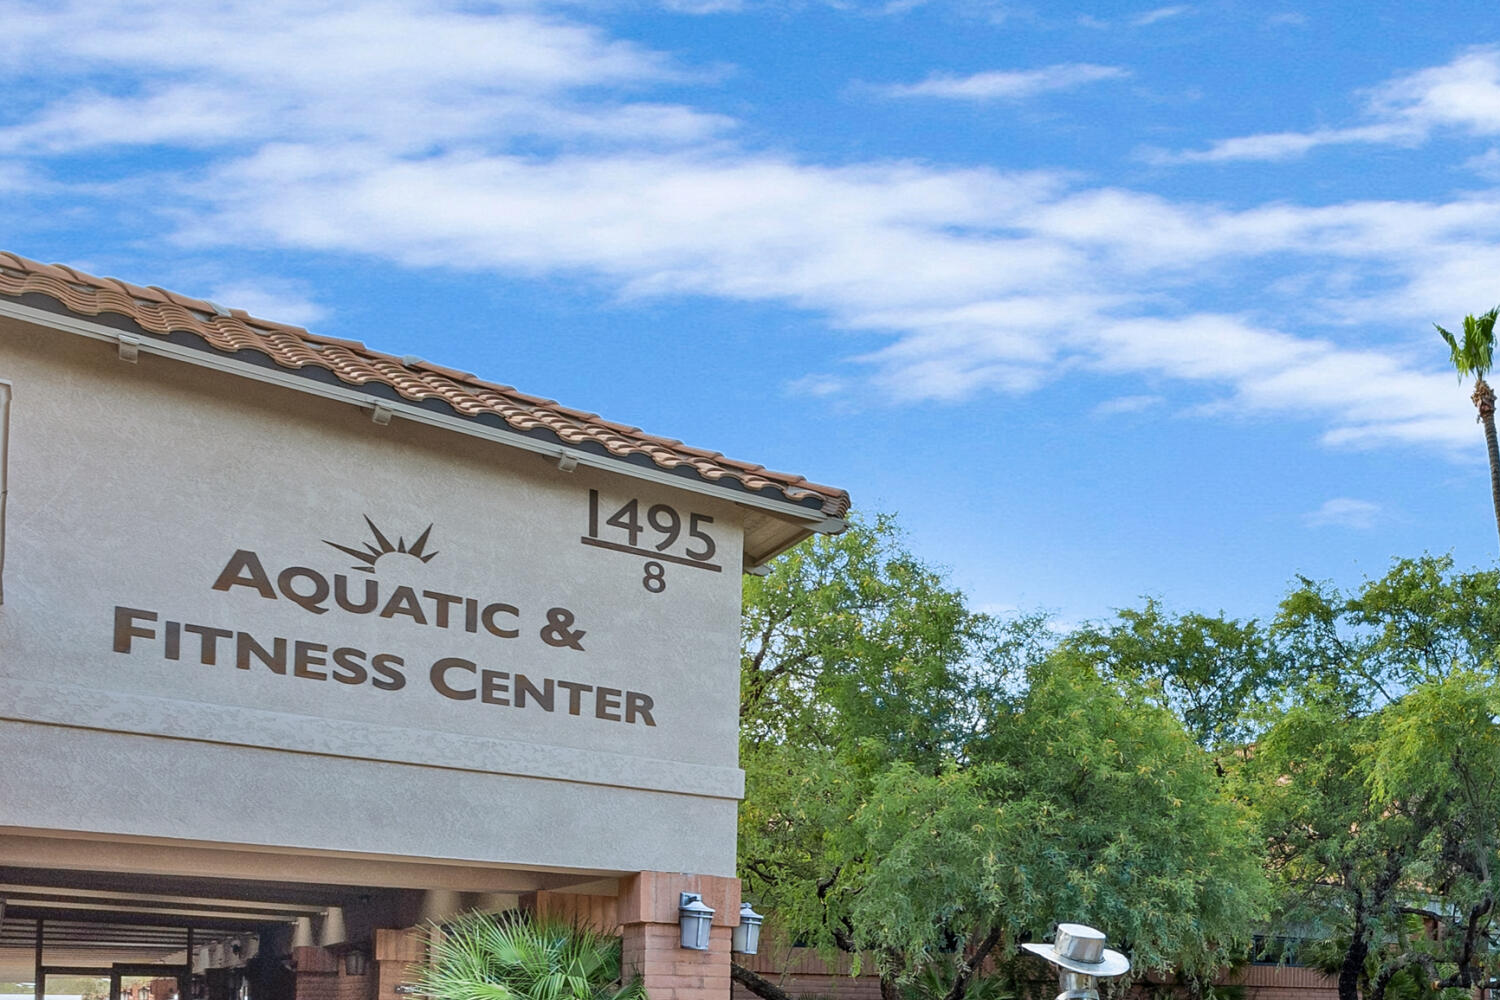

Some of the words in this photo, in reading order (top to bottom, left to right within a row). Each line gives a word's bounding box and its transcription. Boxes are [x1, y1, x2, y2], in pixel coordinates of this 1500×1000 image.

[588, 488, 716, 562] 1495
[212, 548, 520, 639] AQUATIC
[540, 606, 587, 652] &
[642, 560, 667, 594] 8
[112, 605, 407, 691] FITNESS
[429, 657, 657, 727] CENTER
